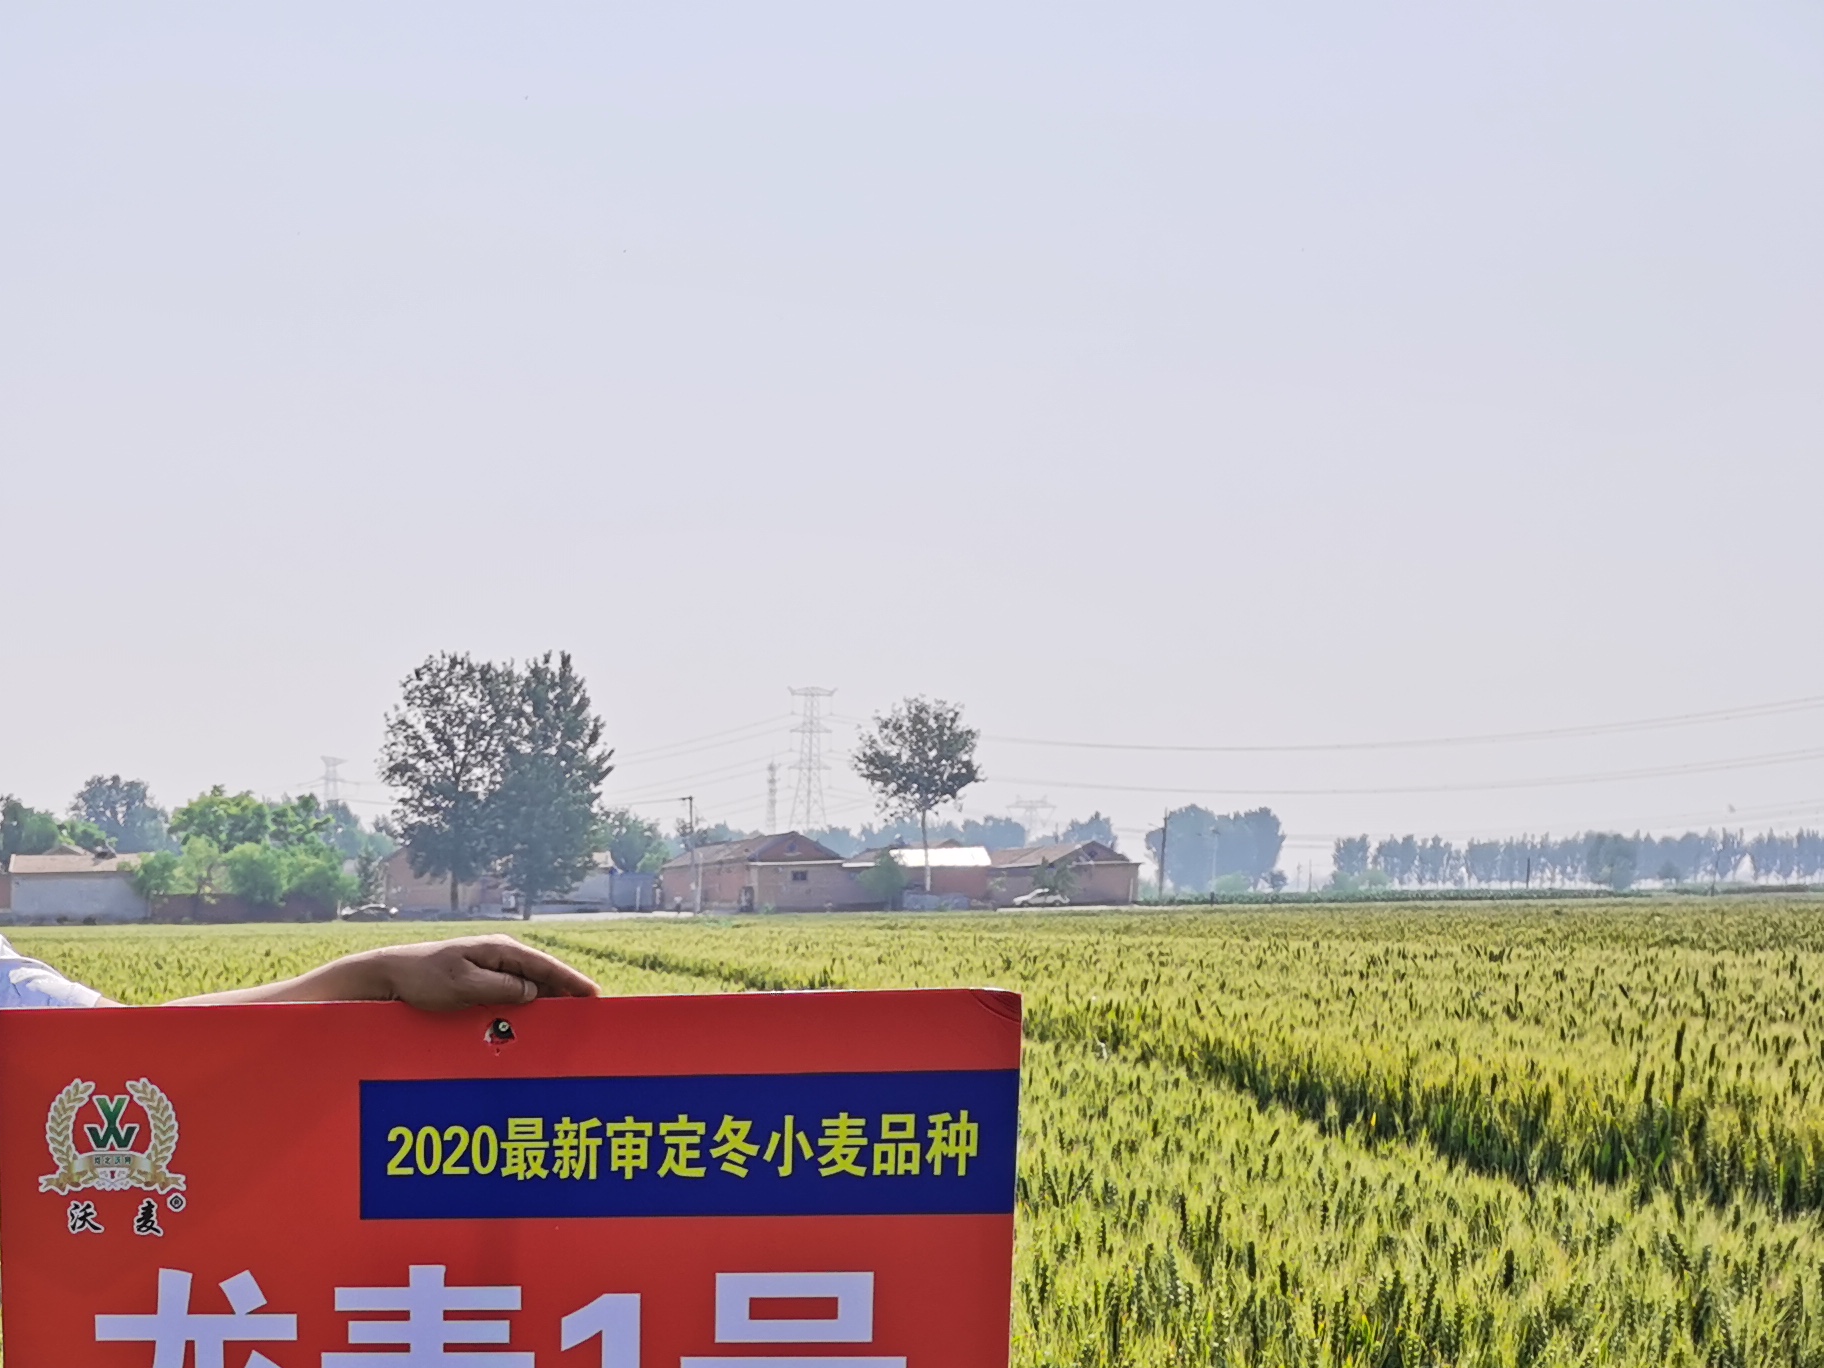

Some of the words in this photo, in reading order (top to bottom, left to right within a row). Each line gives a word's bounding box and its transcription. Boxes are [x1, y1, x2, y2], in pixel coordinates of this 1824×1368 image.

[387, 1111, 978, 1181] 2020最新审定冬小麦品种
